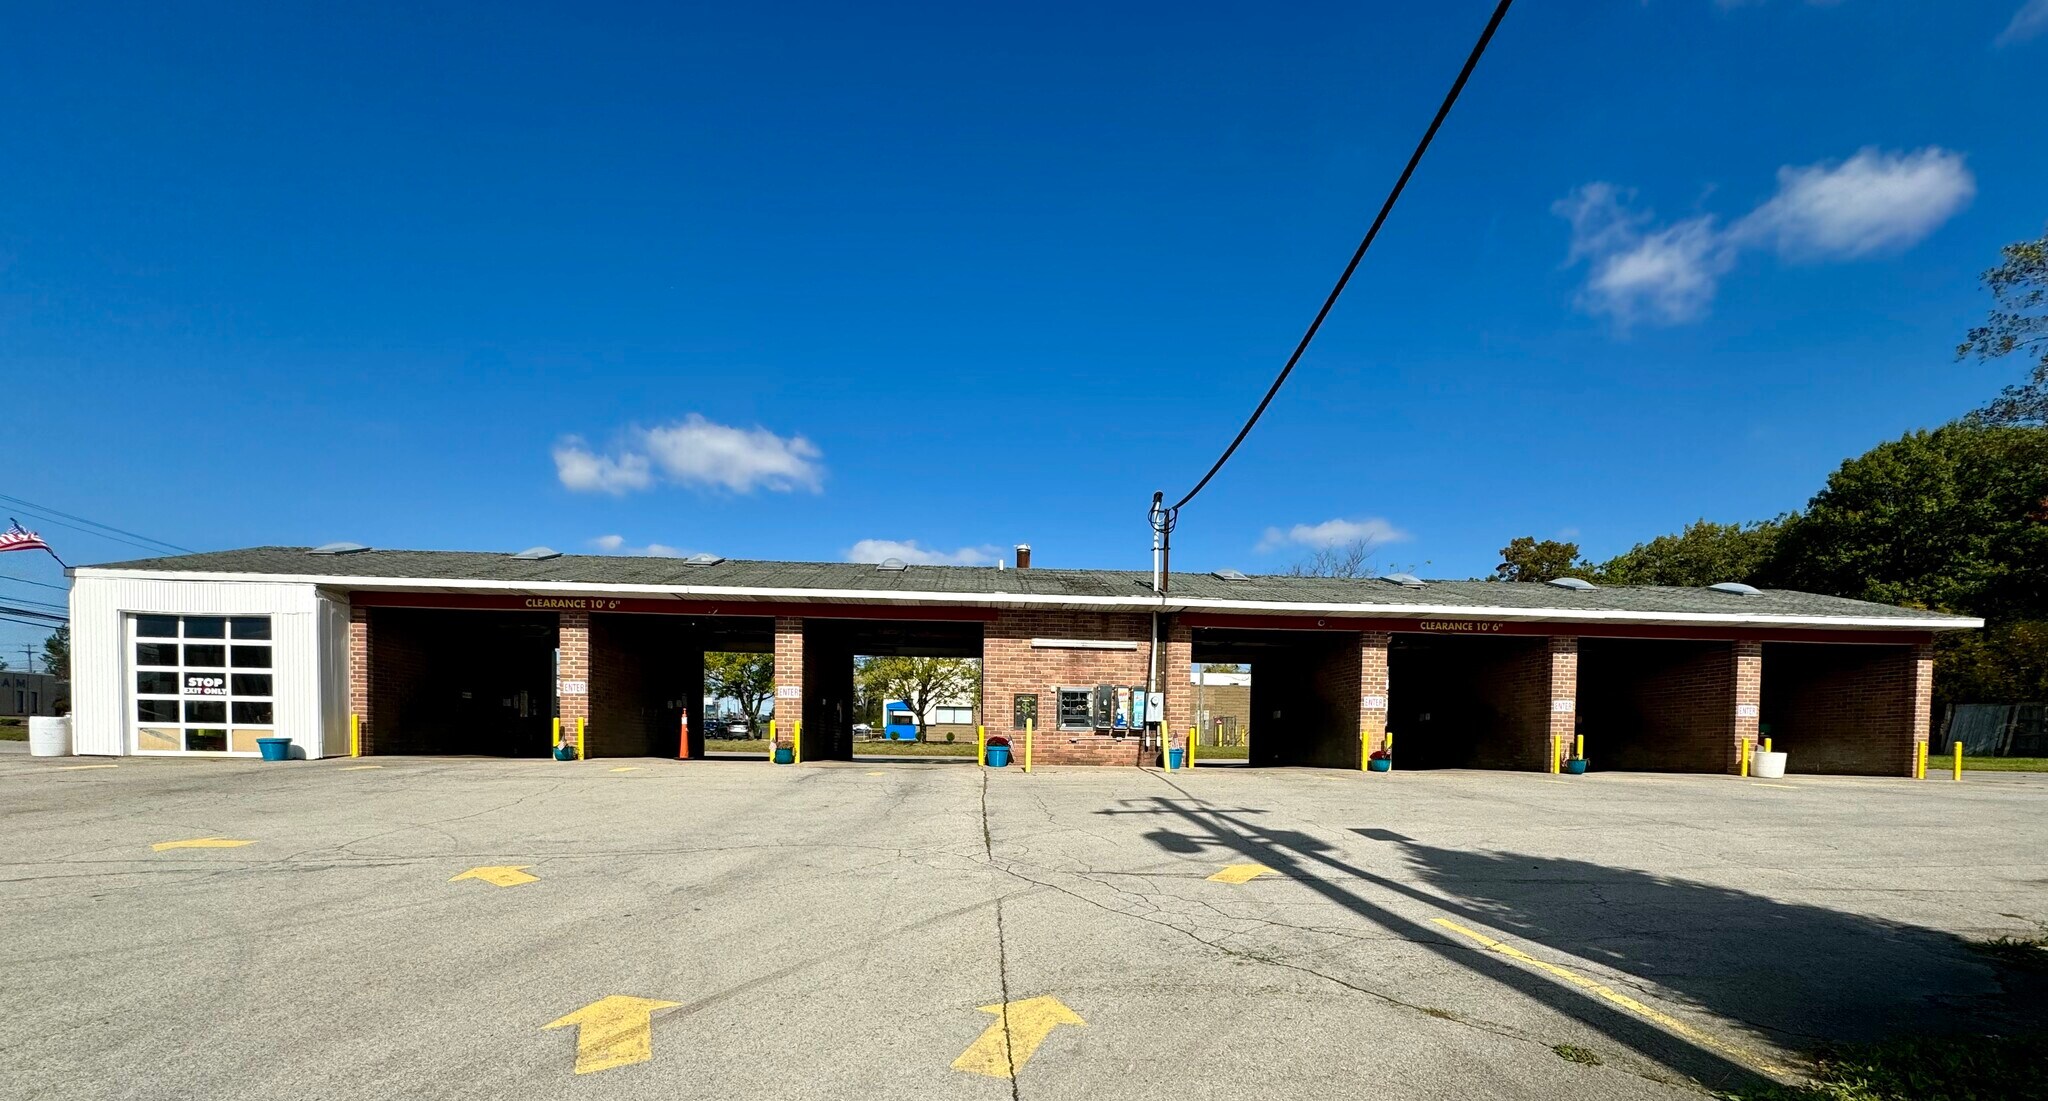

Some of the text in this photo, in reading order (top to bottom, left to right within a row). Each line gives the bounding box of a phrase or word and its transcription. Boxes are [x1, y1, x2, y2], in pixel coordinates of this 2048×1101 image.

[525, 598, 586, 609] CLEARANCE
[590, 599, 606, 609] 10'
[1420, 621, 1473, 631] CLEARANCE
[1476, 622, 1491, 631] 10'
[188, 677, 223, 687] STOP
[564, 683, 585, 692] ENTER
[779, 688, 799, 697] ENTER
[1365, 698, 1382, 706] ENTER
[1554, 702, 1572, 710] ENTER
[1739, 707, 1756, 715] ENTER
